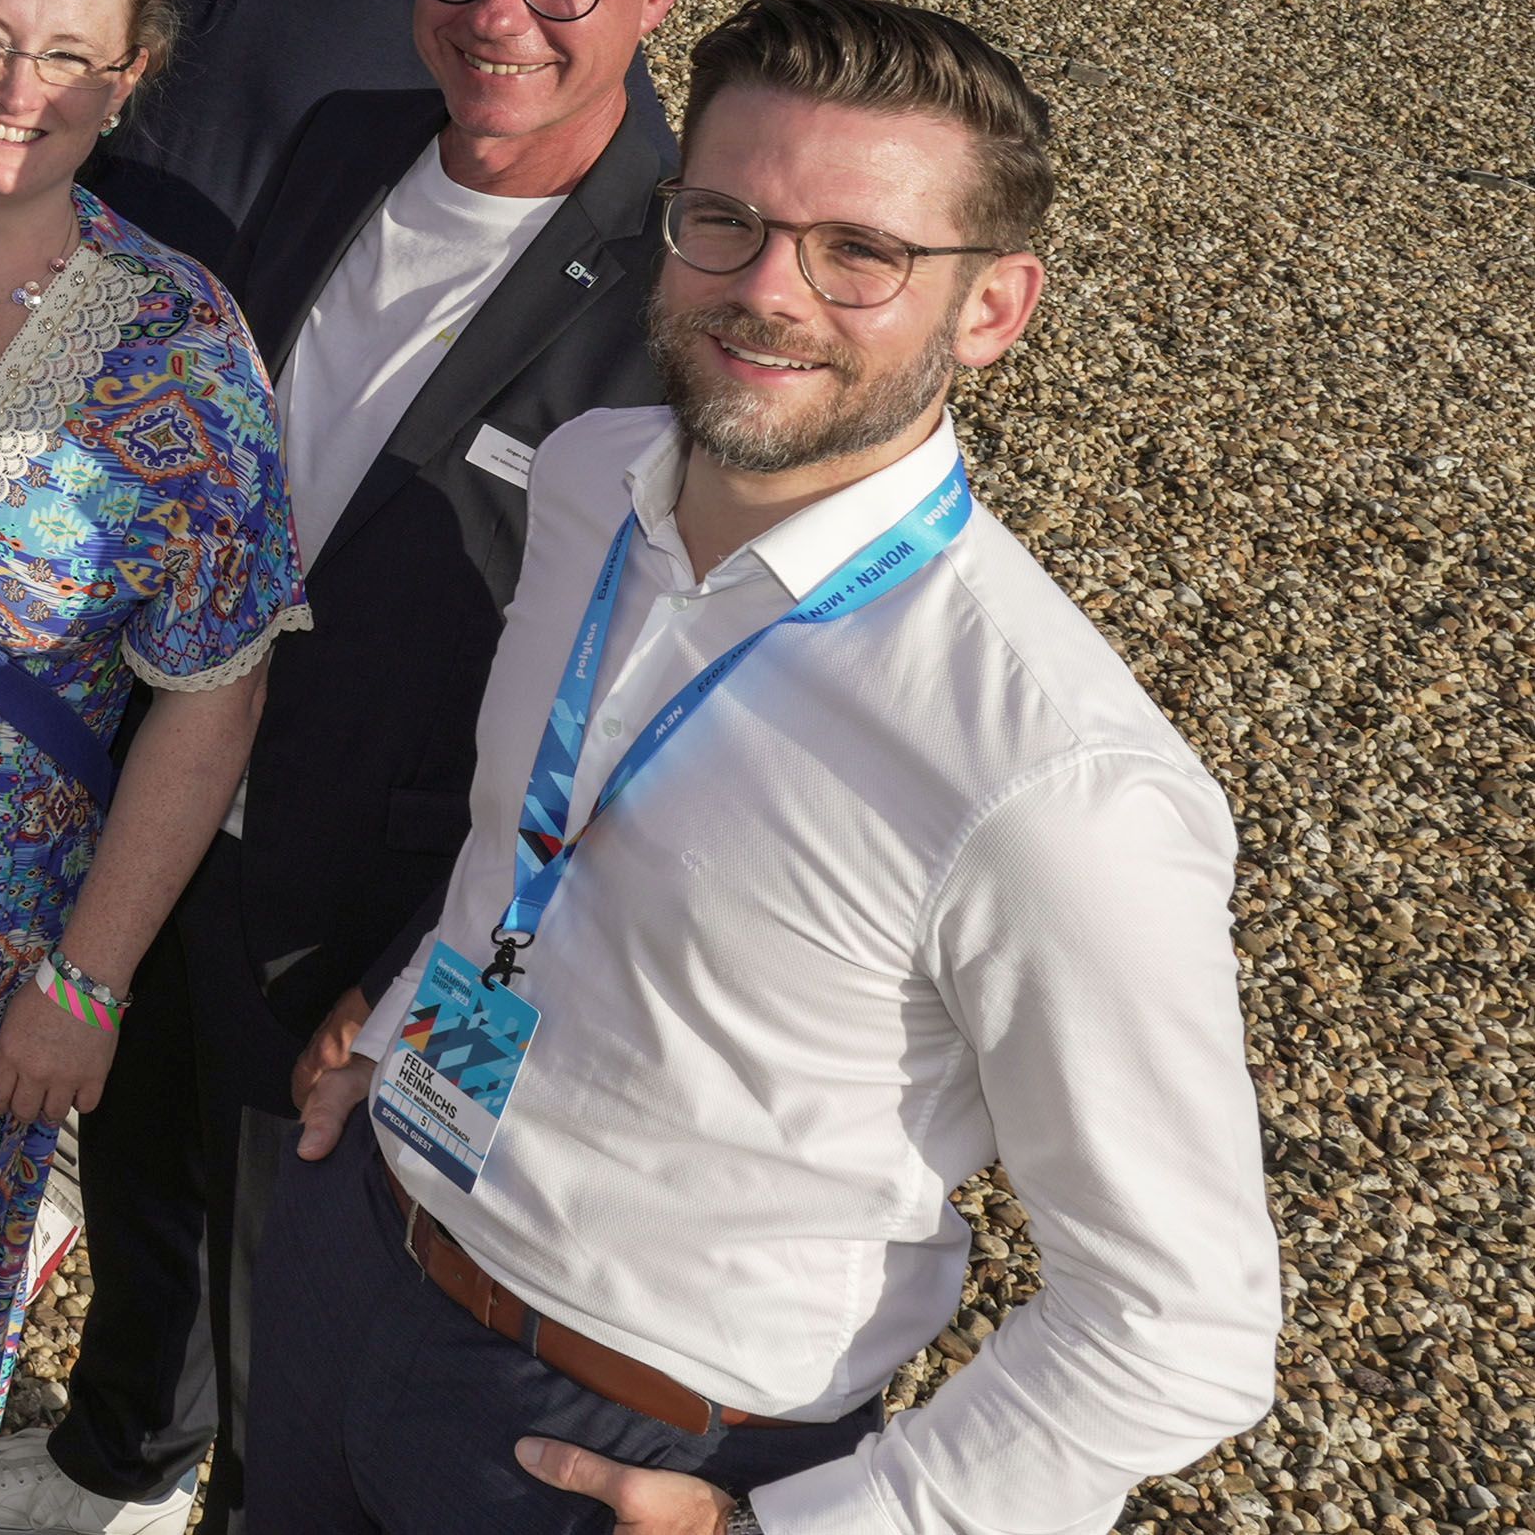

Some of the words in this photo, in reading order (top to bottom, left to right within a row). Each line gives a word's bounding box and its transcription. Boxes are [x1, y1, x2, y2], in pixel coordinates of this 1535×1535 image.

[921, 480, 967, 528] polytan
[855, 539, 916, 589] WOMEN
[809, 590, 846, 620] MEN
[575, 622, 599, 679] polytan
[696, 661, 729, 693] 2023
[653, 705, 685, 738] NEW
[434, 966, 473, 997] CHAMPION
[403, 1053, 436, 1084] FELIX
[395, 1080, 413, 1097] STADT
[413, 1094, 471, 1143] MÖNCHENGLADBACH
[398, 1067, 459, 1119] HEINRICHS
[380, 1107, 411, 1134] SPECIAL
[408, 1130, 434, 1152] GUEST
[419, 1116, 429, 1126] 5
